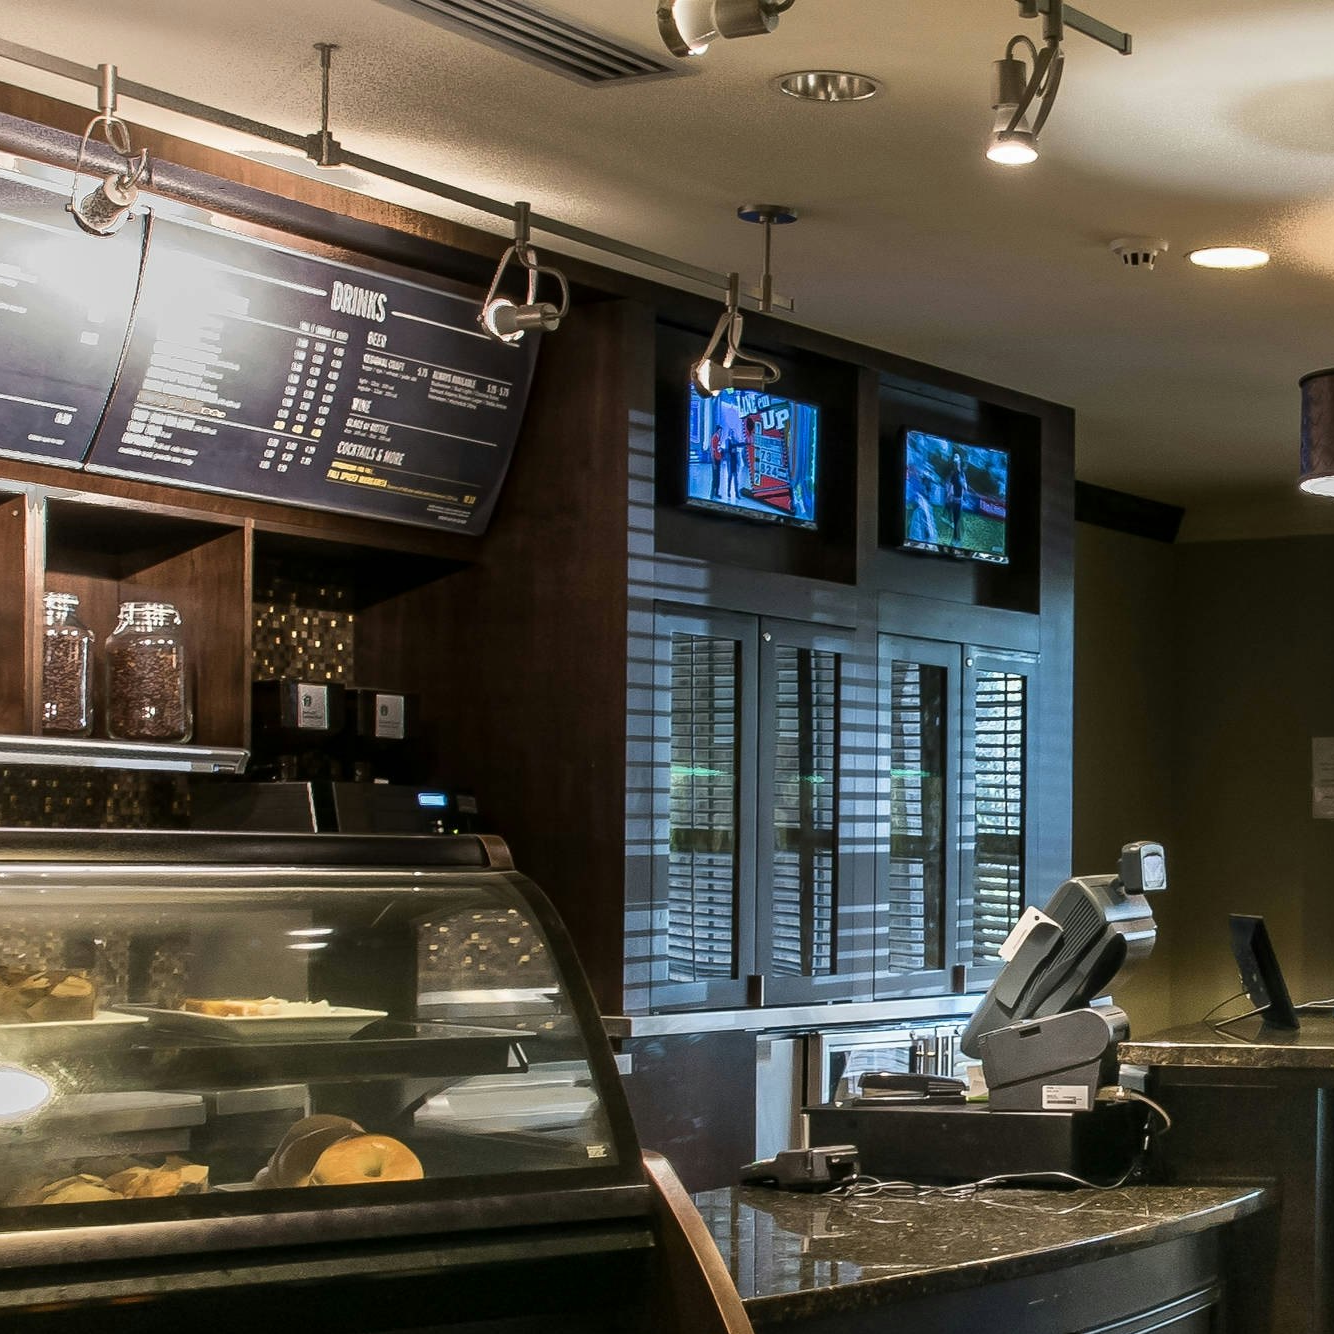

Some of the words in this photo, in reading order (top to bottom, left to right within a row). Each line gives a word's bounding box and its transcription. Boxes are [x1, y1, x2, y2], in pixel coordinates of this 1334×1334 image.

[330, 280, 388, 323] DRINKS
[366, 330, 388, 349] BEER
[736, 394, 757, 419] LINE
[761, 409, 790, 430] UP
[336, 440, 377, 462] COCKTAILS
[375, 449, 383, 462] &
[383, 450, 406, 466] MORE
